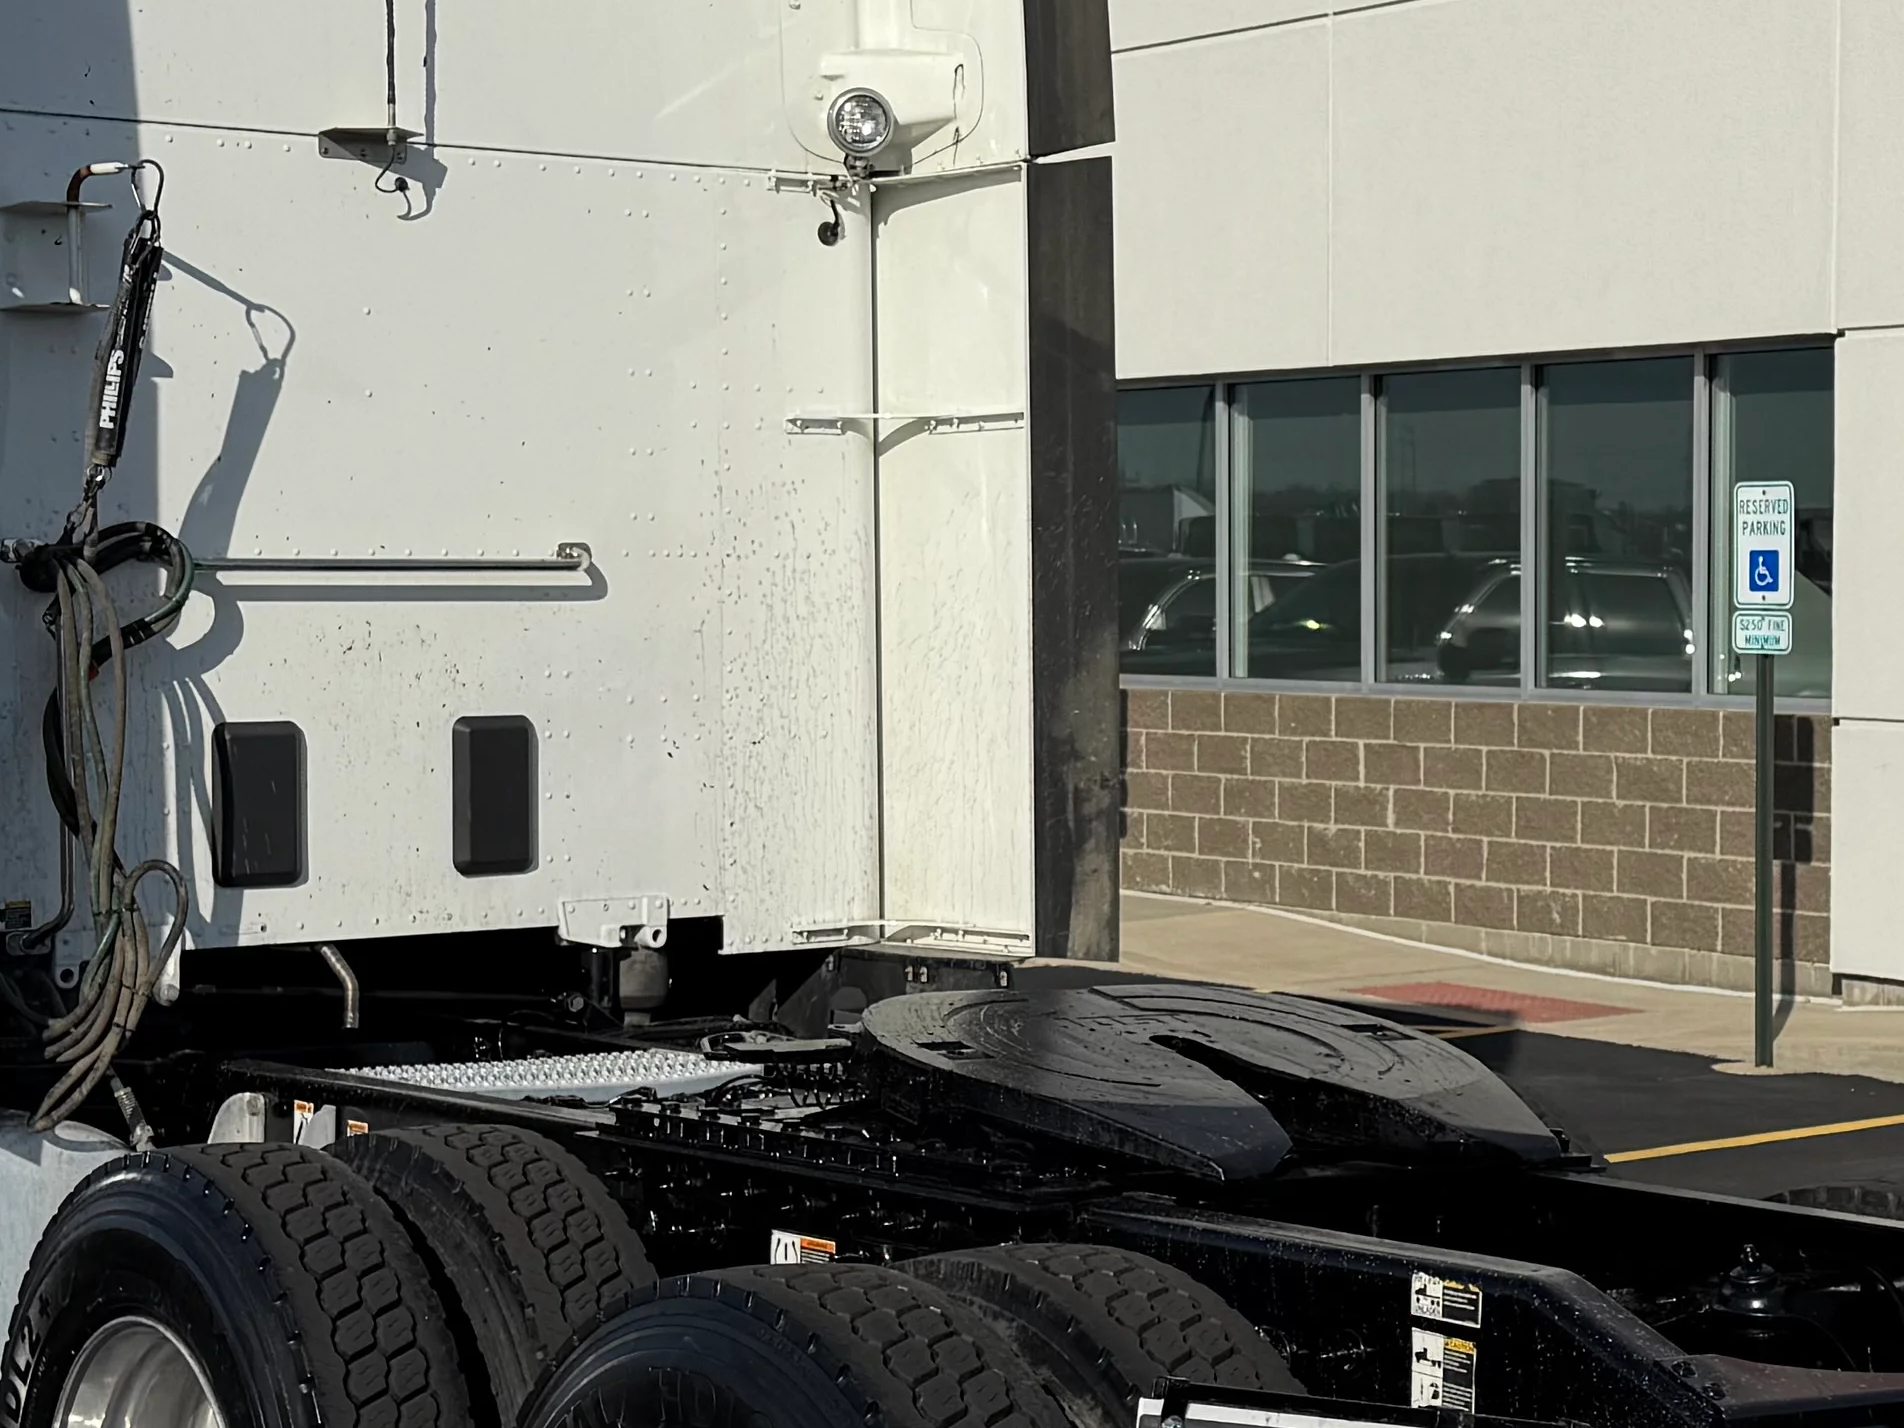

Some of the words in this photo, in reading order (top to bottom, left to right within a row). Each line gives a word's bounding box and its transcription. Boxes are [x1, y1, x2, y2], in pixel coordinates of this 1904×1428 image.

[99, 349, 125, 430] PHILLIPS
[1739, 498, 1789, 515] RESERVED
[1742, 520, 1786, 536] PARKING
[1739, 619, 1763, 632] $250
[1768, 619, 1786, 633] FINE
[1744, 634, 1781, 646] MINIMUM
